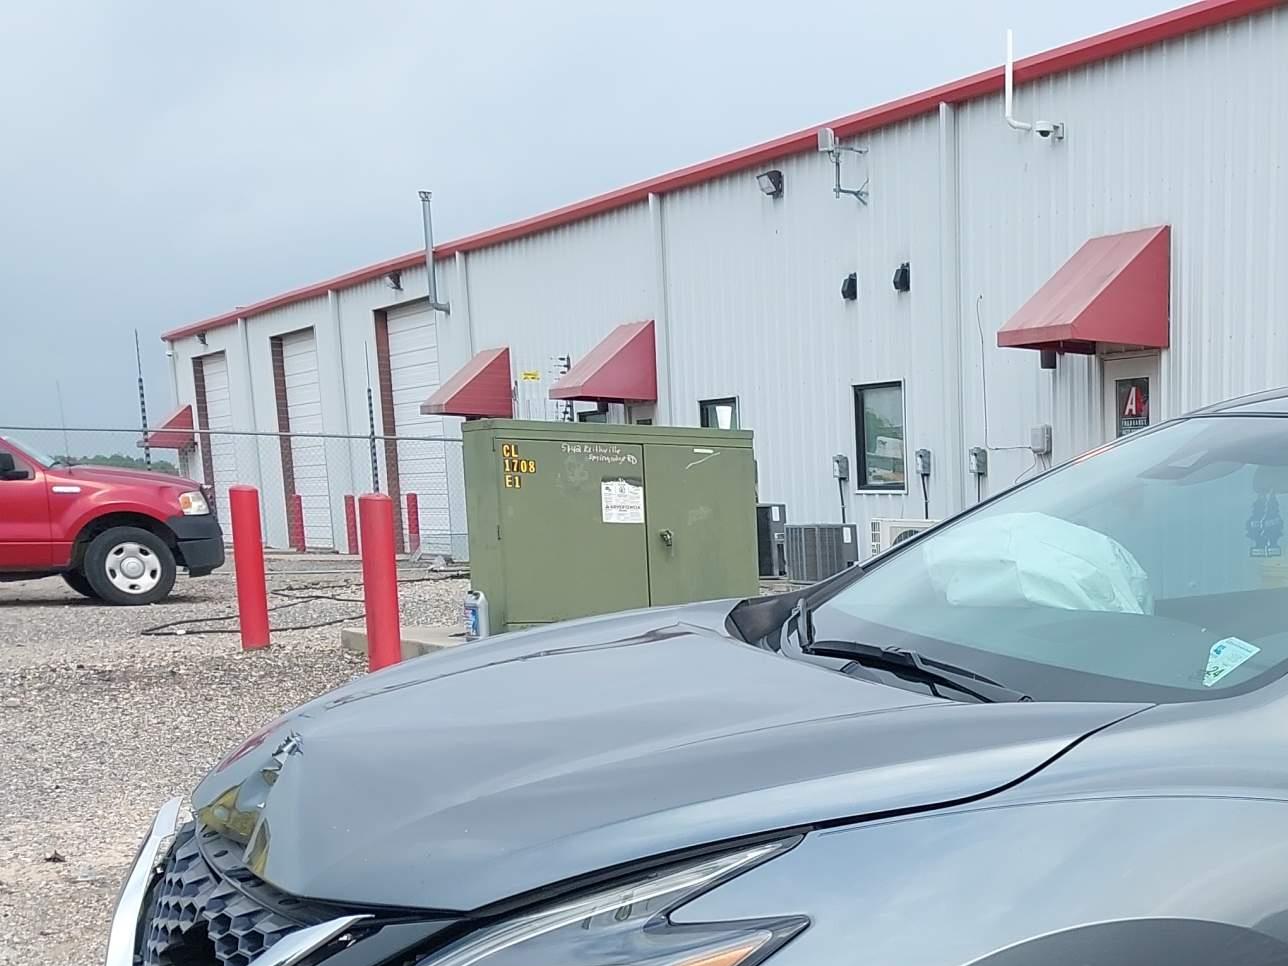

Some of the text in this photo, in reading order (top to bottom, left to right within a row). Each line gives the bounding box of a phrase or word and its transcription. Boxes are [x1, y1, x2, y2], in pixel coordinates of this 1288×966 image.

[503, 444, 518, 457] CL
[504, 459, 536, 473] 1708
[505, 475, 521, 488] E1
